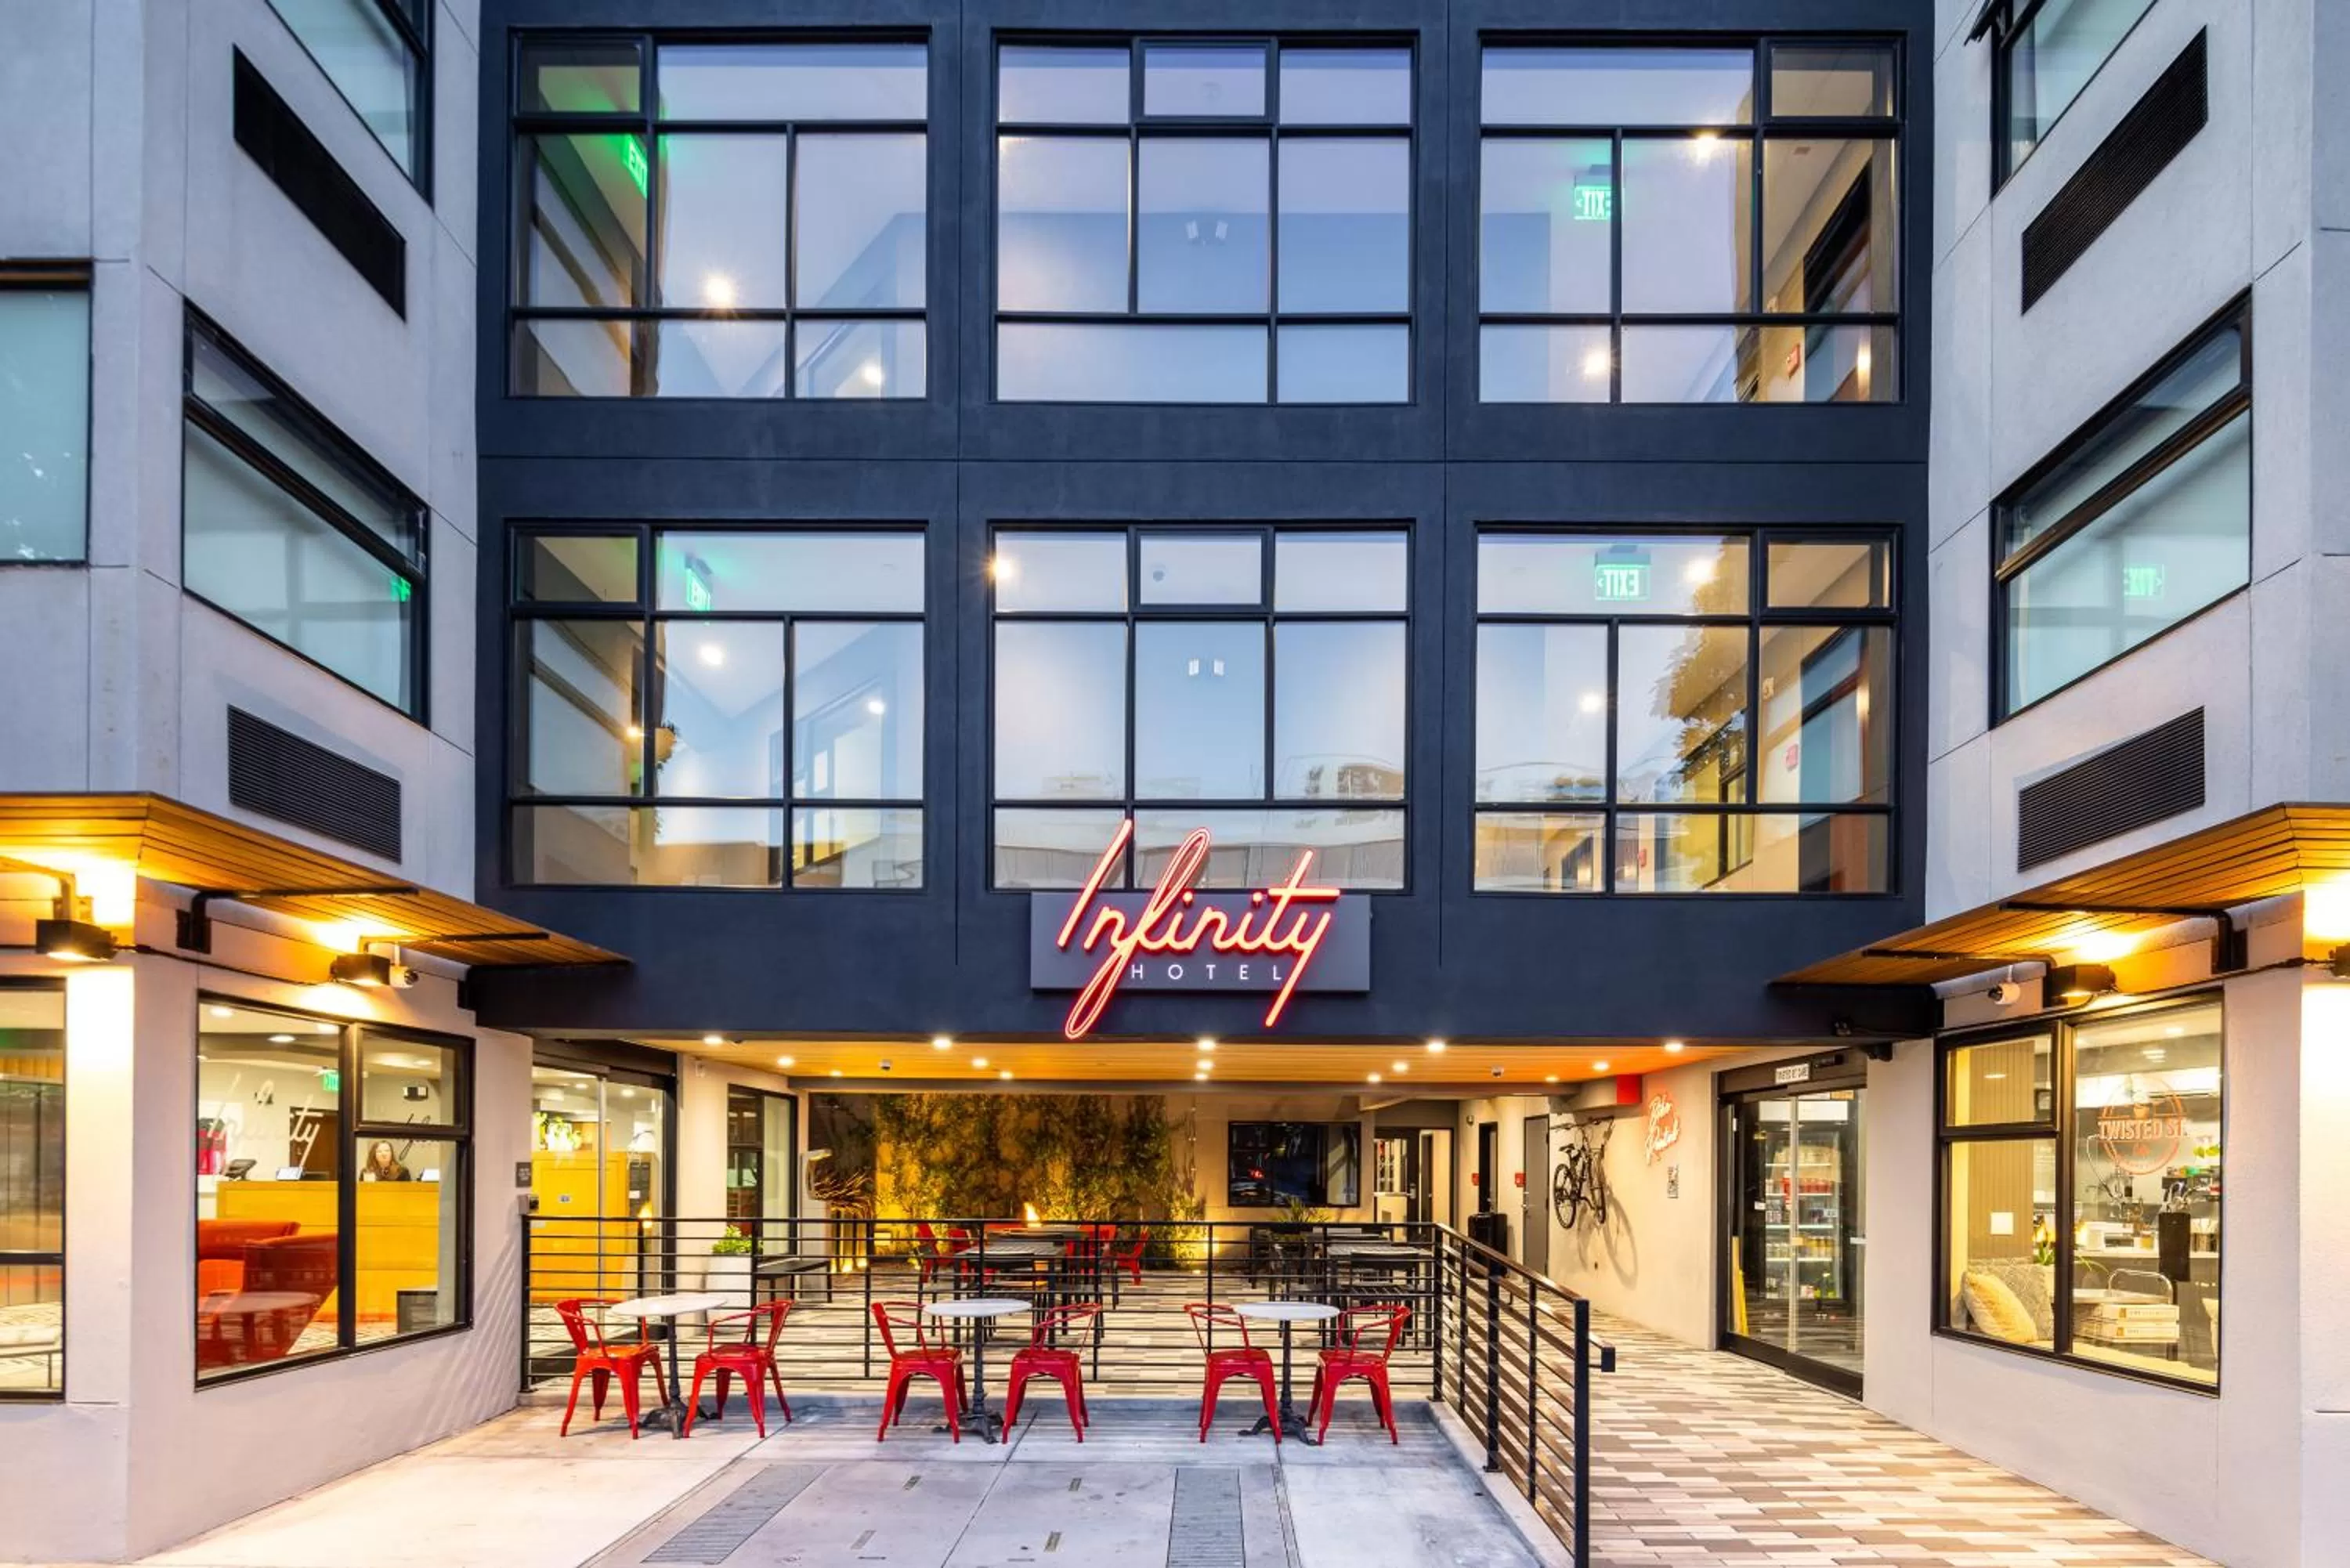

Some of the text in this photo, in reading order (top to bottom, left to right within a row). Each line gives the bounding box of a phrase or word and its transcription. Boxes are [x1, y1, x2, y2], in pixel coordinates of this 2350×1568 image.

[1057, 818, 1341, 1040] Infinity
[1130, 963, 1282, 981] HOTEL
[2098, 1118, 2163, 1140] TWISTED
